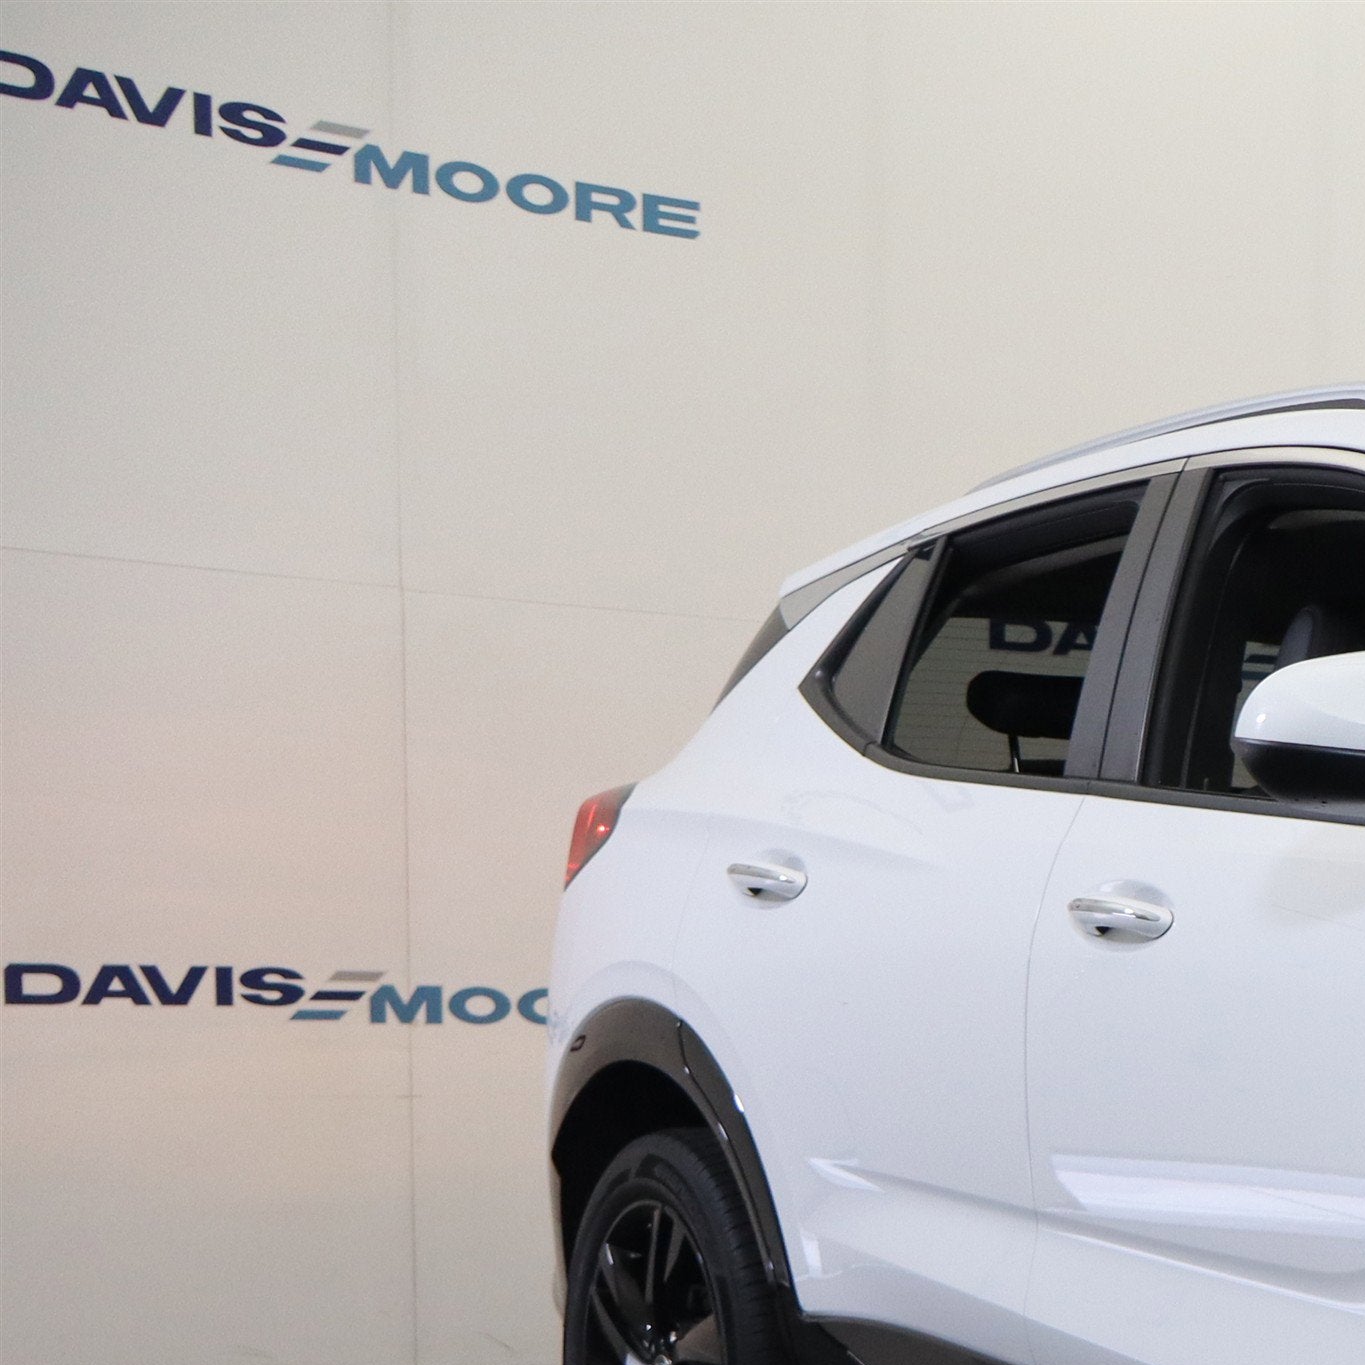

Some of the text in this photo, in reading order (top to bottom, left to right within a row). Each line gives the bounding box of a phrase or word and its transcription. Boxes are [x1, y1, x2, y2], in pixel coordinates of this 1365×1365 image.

[0, 49, 701, 240] DAVIS MOORE
[2, 961, 306, 1008] DAVIS
